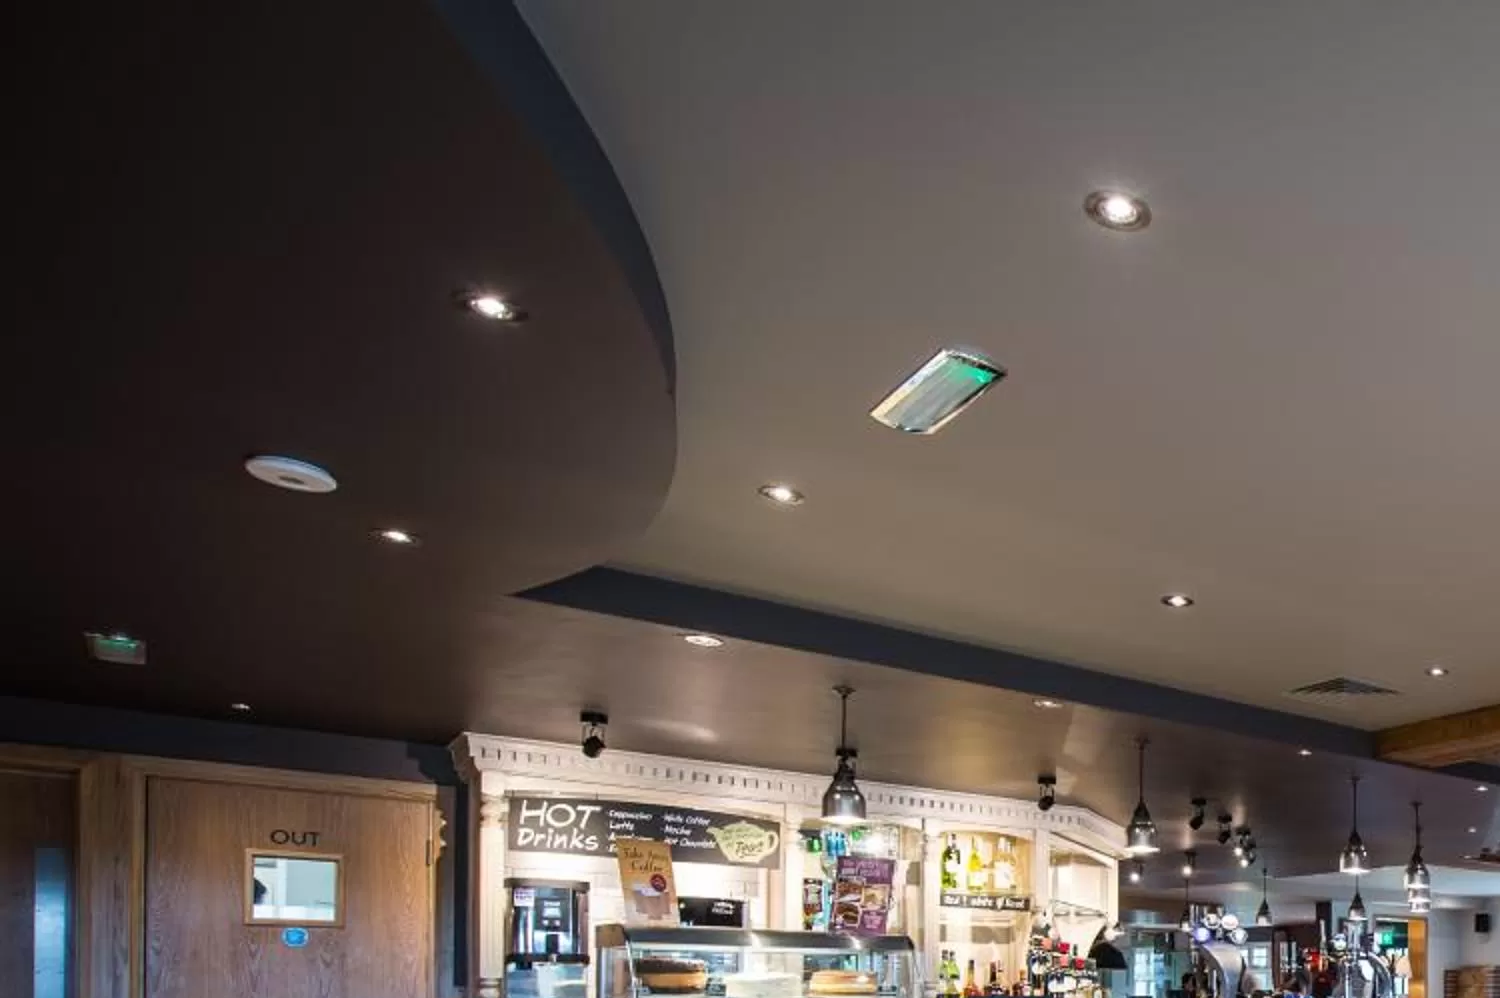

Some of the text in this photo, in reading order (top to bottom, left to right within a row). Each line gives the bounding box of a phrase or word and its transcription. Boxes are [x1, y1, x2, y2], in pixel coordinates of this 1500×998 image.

[519, 799, 602, 829] HOT
[270, 829, 320, 846] OUT
[517, 826, 599, 851] Drinks
